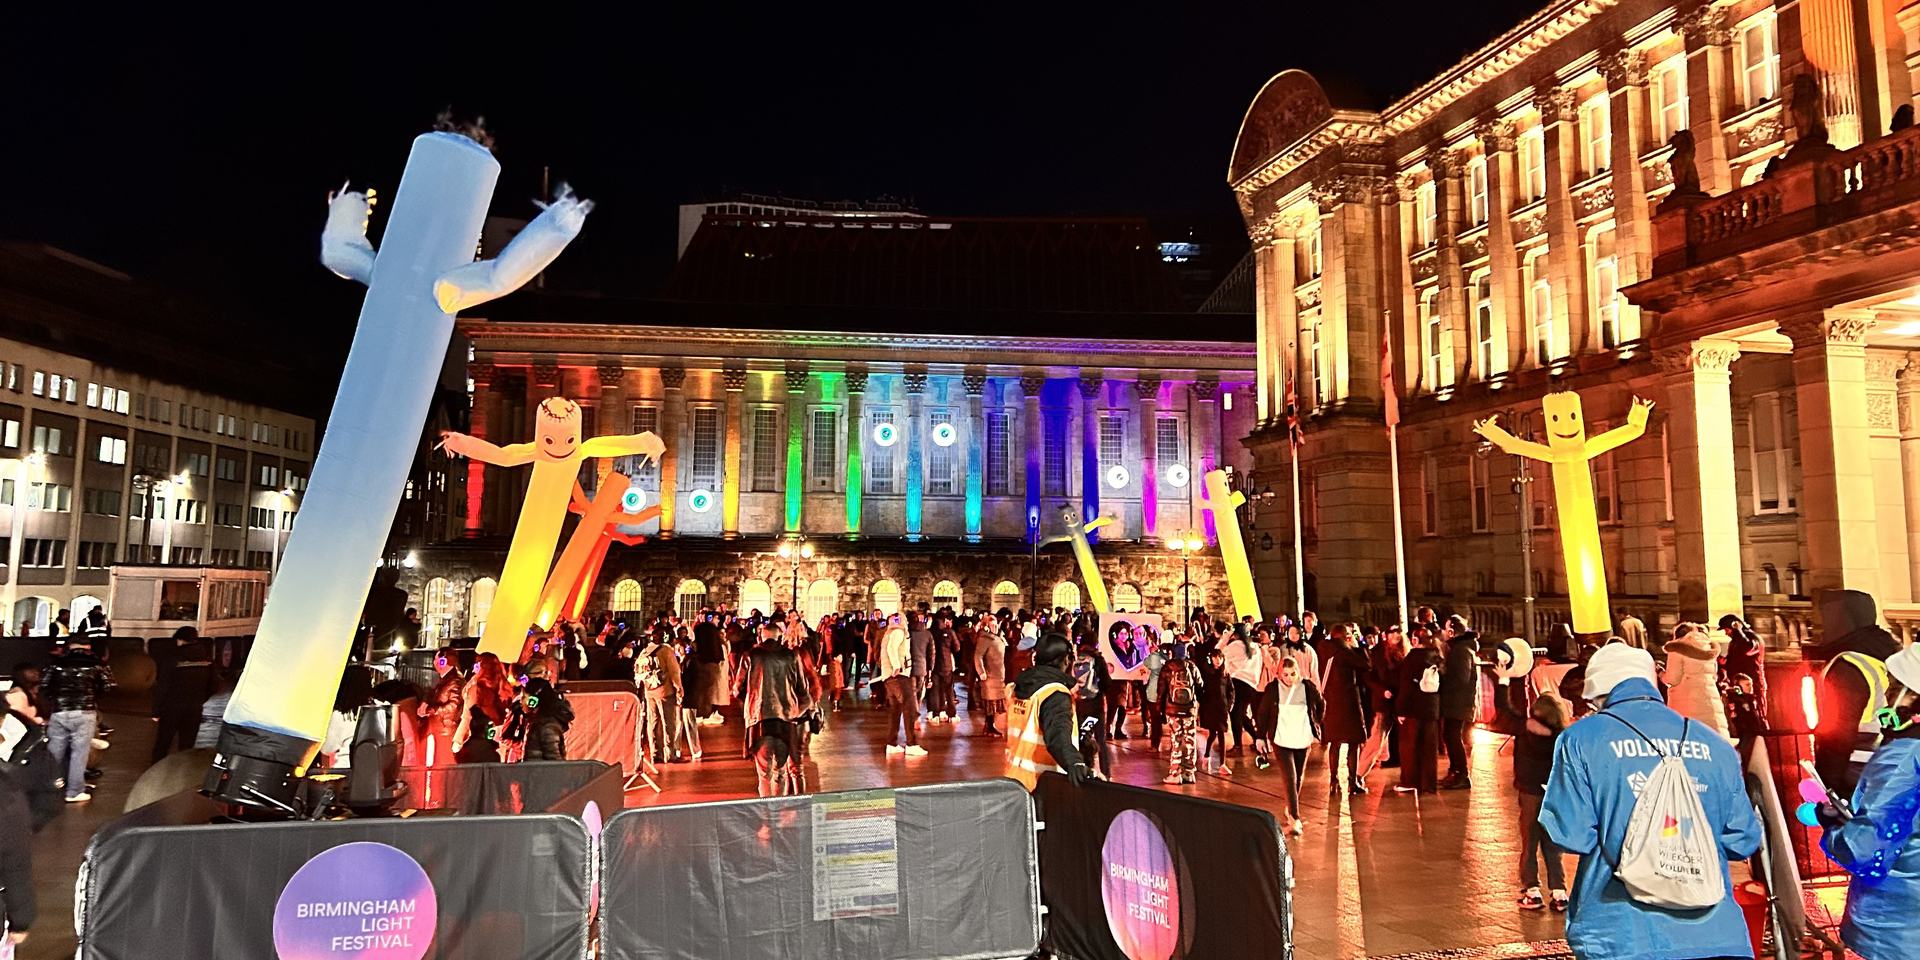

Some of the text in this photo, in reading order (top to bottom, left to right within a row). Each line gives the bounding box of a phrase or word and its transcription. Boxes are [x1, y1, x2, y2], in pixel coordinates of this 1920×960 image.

[1610, 738, 1712, 762] VOLUNTEER
[1110, 862, 1169, 893] BIRMINGHAM
[297, 899, 416, 918] BIRMINGHAM
[1143, 890, 1169, 909] LIGHT
[361, 916, 414, 932] LIGHT
[1129, 903, 1171, 929] FESTIVAL
[331, 934, 413, 951] FESTIVAL
